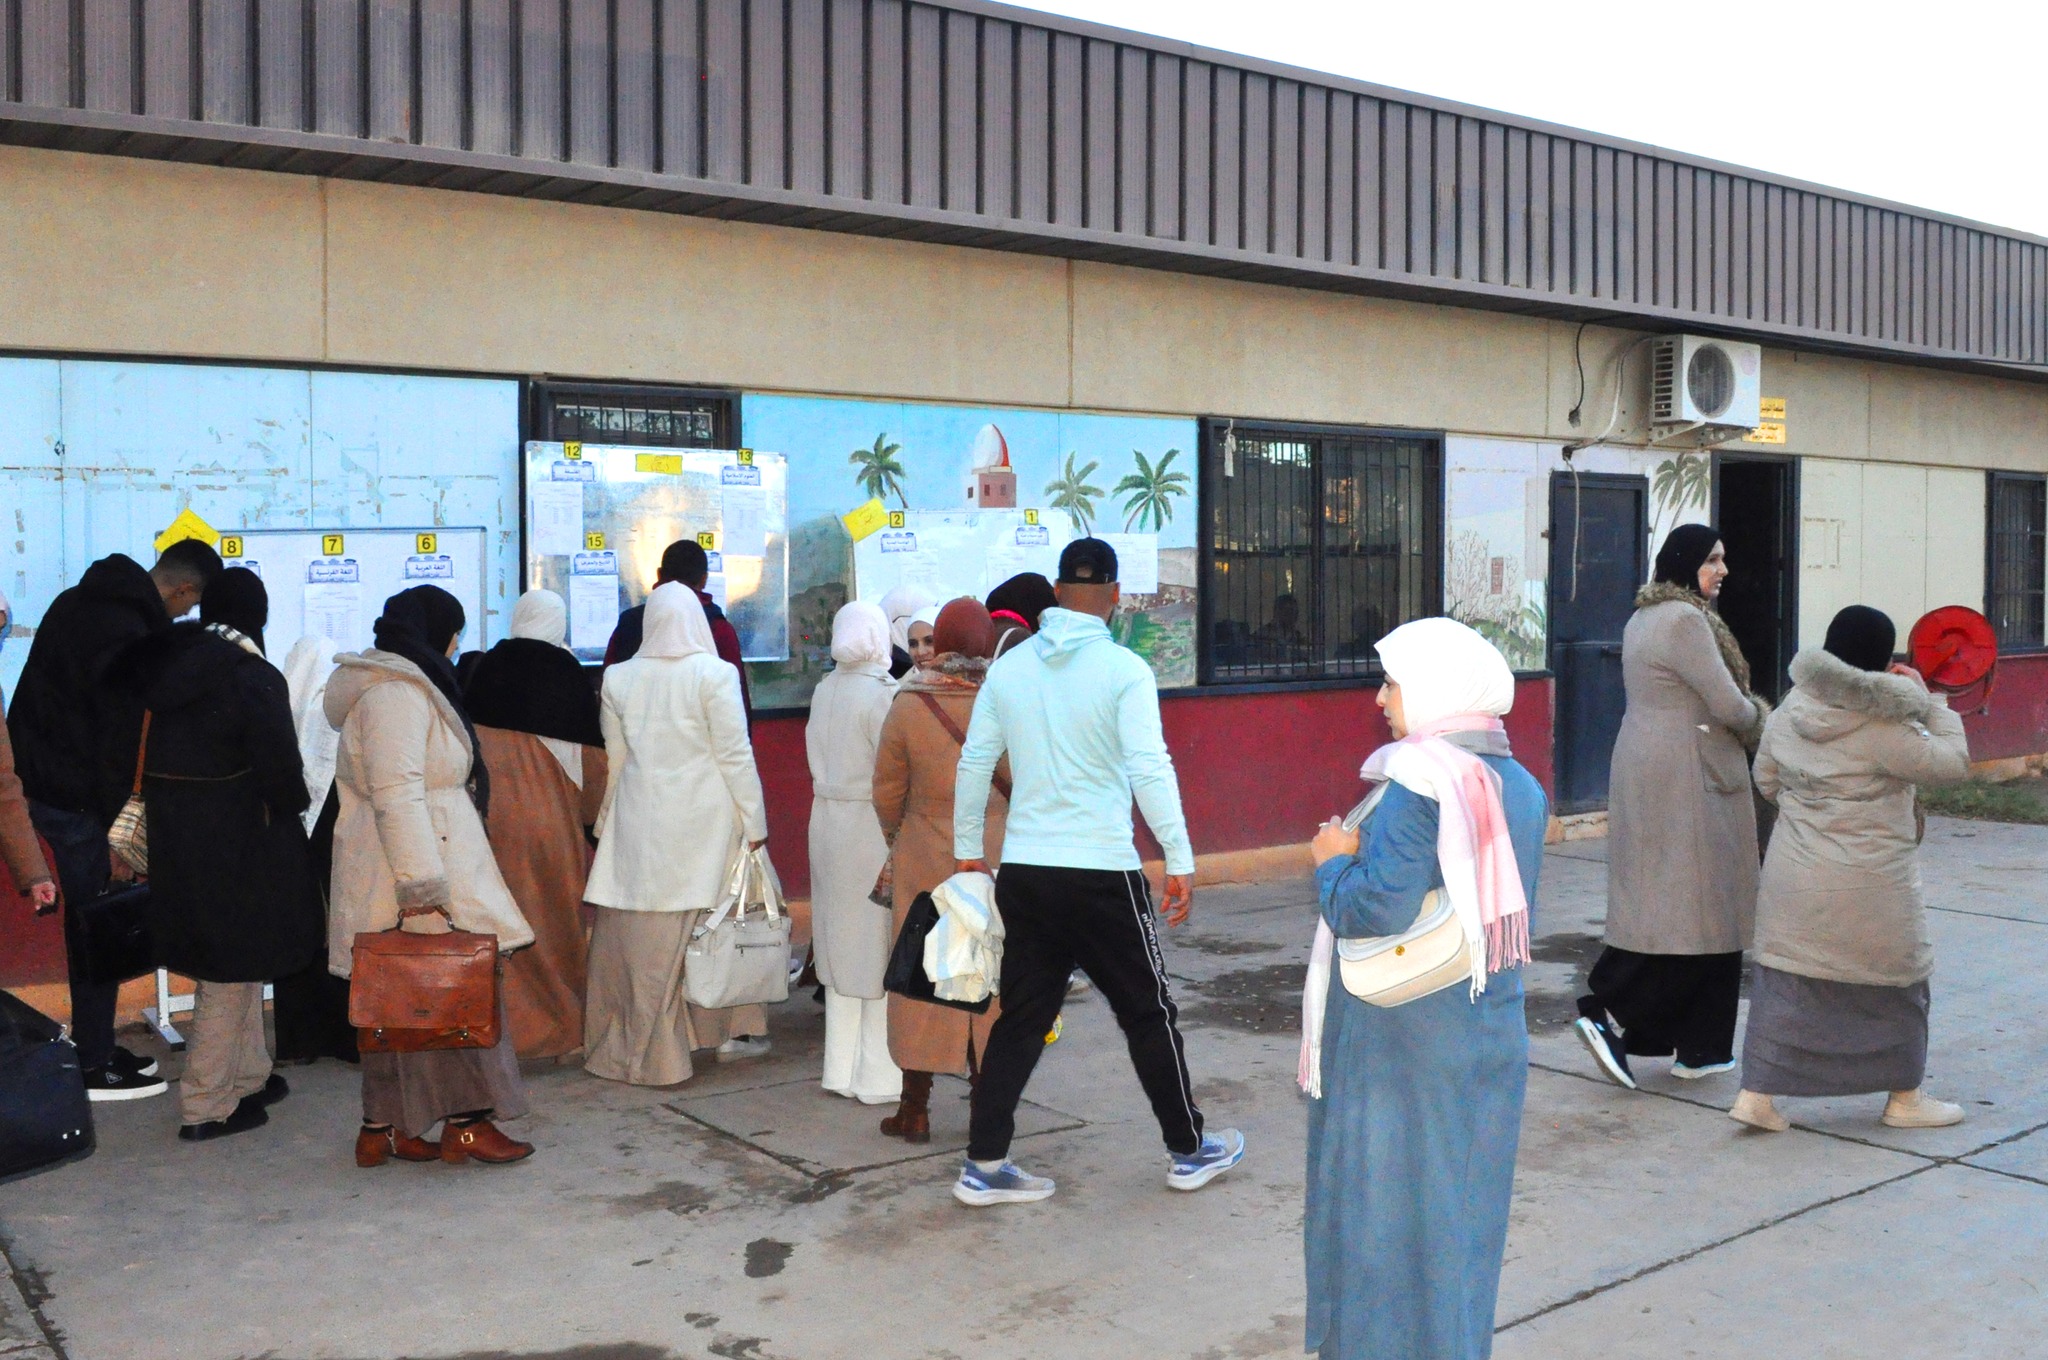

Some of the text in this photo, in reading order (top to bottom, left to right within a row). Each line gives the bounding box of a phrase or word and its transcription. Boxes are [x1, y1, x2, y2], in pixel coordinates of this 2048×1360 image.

[566, 445, 580, 456] 12
[739, 451, 751, 462] 13
[893, 513, 901, 525] 2
[1029, 511, 1035, 523] 1
[328, 538, 338, 552] 7
[422, 537, 431, 550] 6
[587, 536, 602, 547] 15
[698, 535, 712, 546] 14
[227, 540, 237, 554] 8
[315, 567, 354, 577] اللغة الفرنسية
